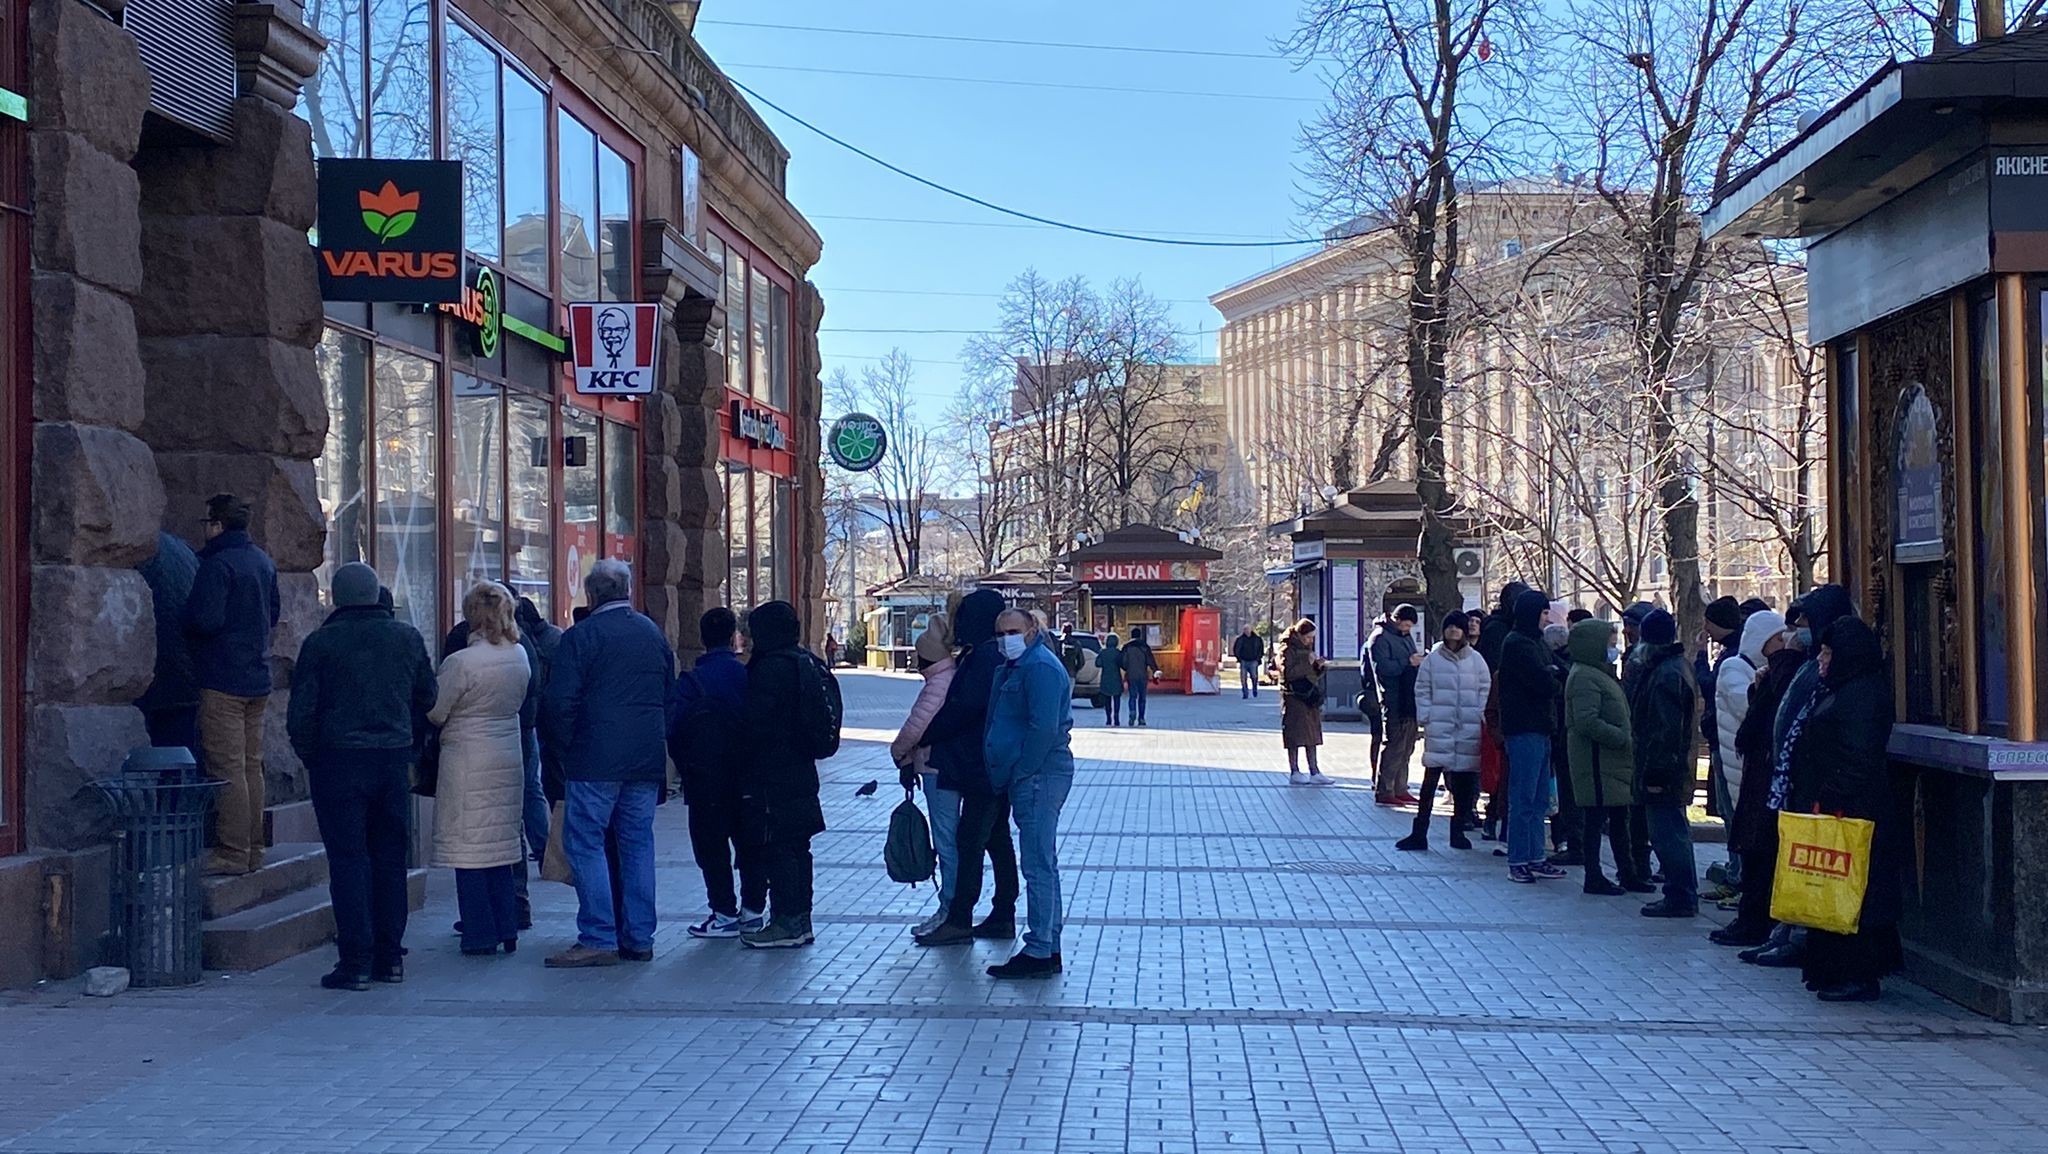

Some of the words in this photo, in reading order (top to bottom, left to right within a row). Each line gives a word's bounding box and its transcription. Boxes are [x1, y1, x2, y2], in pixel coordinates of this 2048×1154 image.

[1996, 156, 2048, 175] ЯКІСНЕ
[322, 251, 457, 278] VARUS
[588, 371, 640, 388] KFC
[836, 420, 878, 431] MOJITO
[1094, 565, 1160, 580] SULTAN
[1793, 848, 1846, 873] BILLA
